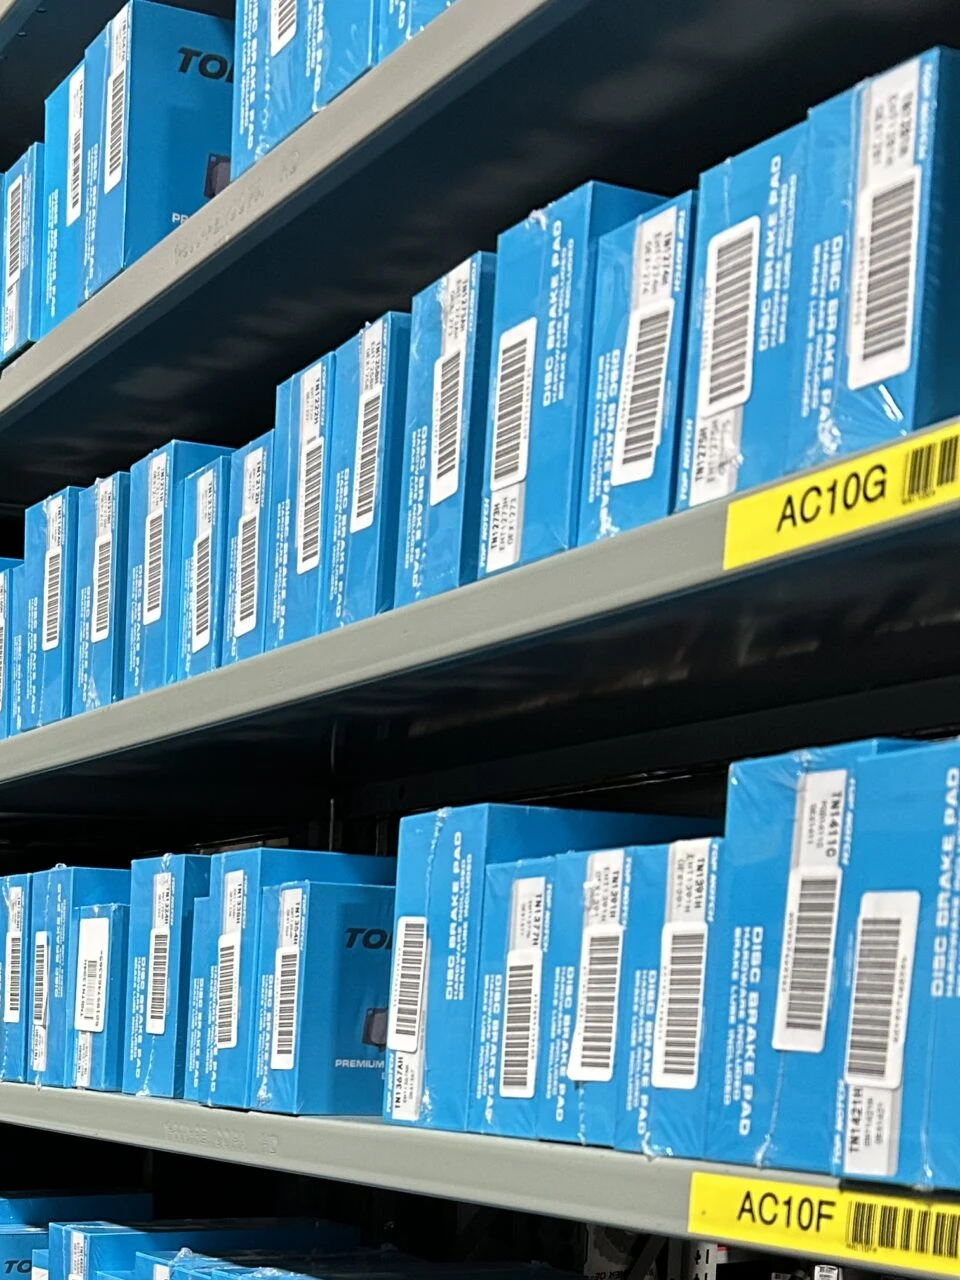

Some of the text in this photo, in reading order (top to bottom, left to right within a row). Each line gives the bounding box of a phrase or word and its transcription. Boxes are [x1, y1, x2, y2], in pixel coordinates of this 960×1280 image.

[758, 156, 781, 352] DISC BRAKE PAD
[830, 235, 843, 291] DISC
[543, 220, 562, 408] DISC BRAKE PAD
[822, 299, 838, 380] BRAKE
[679, 419, 692, 500] TOP NOTCH
[482, 496, 490, 533] NOTCH
[490, 503, 500, 551] TN1273H
[775, 464, 887, 533] AC10G
[446, 832, 462, 1000] DISC BRAKE PAD
[930, 768, 960, 997] DISC BRAKE PAD
[345, 927, 392, 948] TO
[494, 974, 502, 1014] DISC
[724, 927, 741, 1106] BRAKE LUBE INCLUDED
[732, 926, 750, 1101] HARDWARE INCLUDED
[490, 1020, 500, 1080] BRAKE
[556, 966, 574, 1122] DISC BRAKE PAD
[638, 970, 657, 1135] DISC BRAKE PAD
[739, 927, 764, 1136] DISC BRAKE PAD
[394, 1056, 404, 1109] TN1367AH
[832, 1134, 842, 1163] TOP
[849, 1087, 864, 1152] TN1421H
[737, 1189, 836, 1232] AC10F
[4, 1259, 32, 1274] TO
